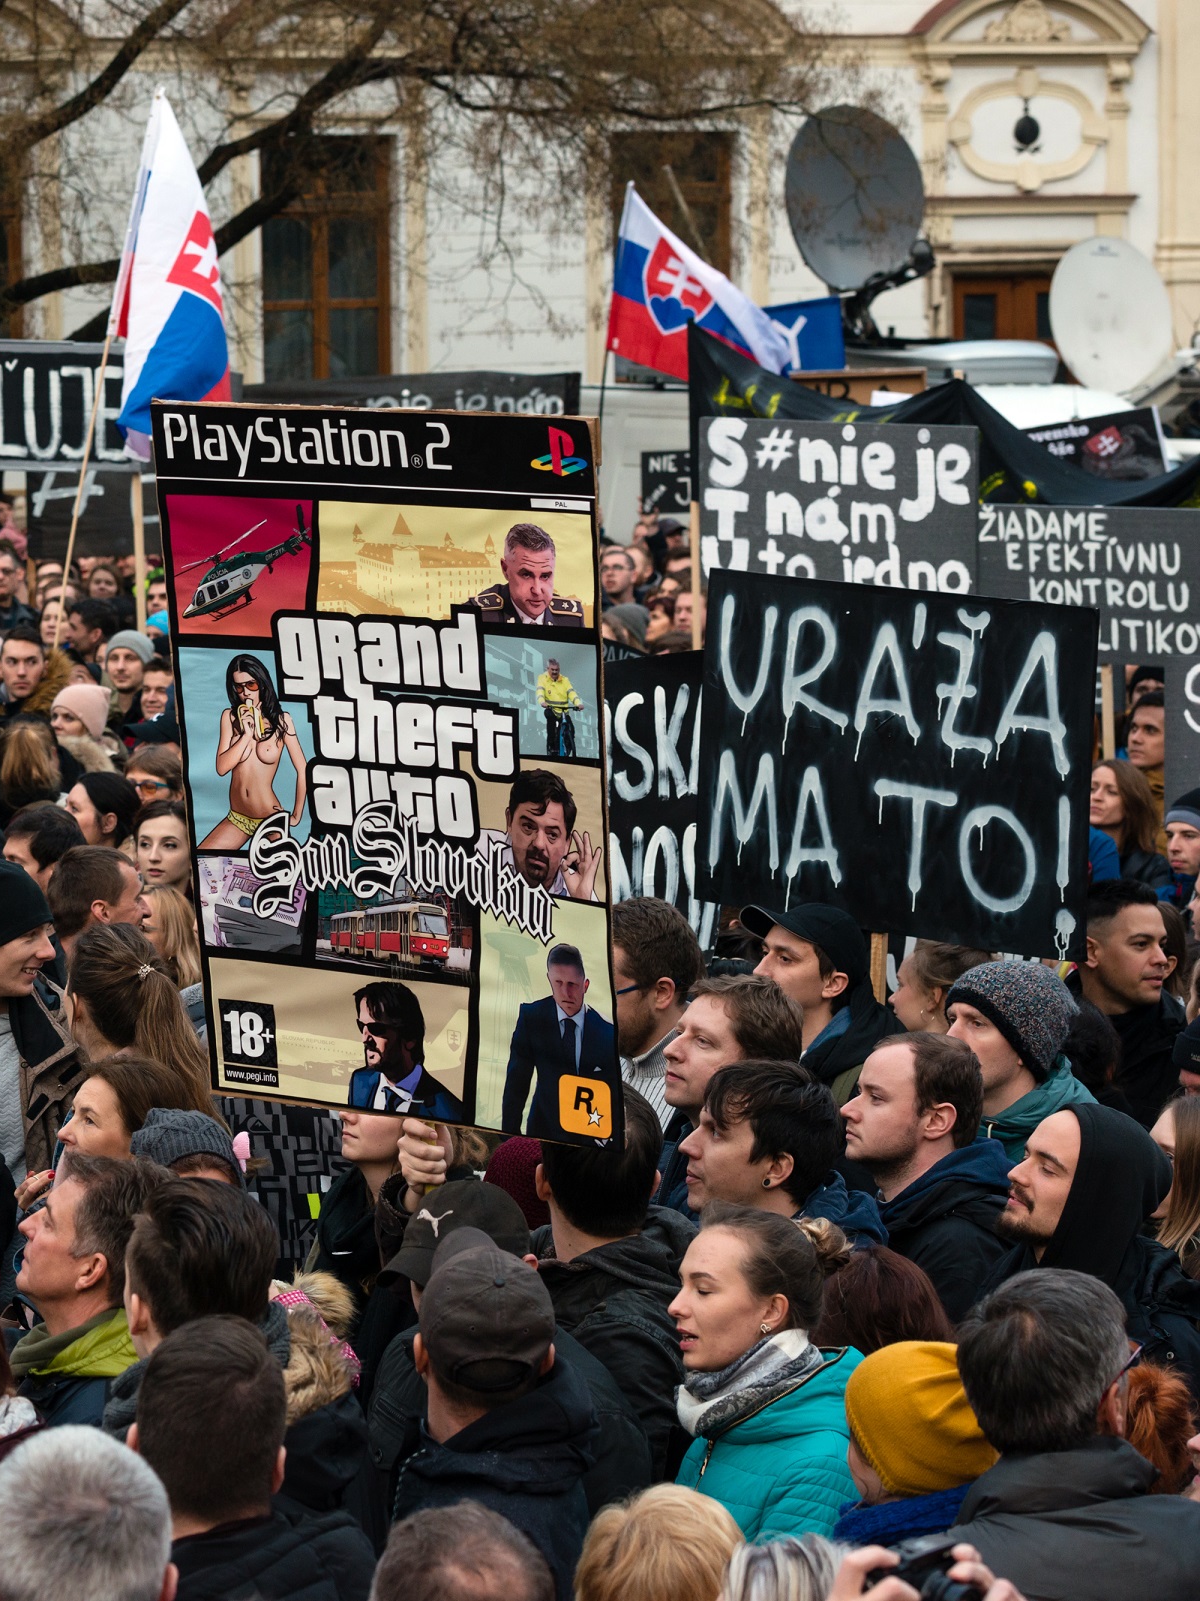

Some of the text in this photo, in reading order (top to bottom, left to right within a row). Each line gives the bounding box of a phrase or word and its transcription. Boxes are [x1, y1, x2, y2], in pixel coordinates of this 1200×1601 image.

[1027, 424, 1090, 443] vensko
[765, 485, 897, 545] nám
[978, 504, 1110, 543] ŽIADAME
[1028, 576, 1190, 612] KONTROLU
[709, 748, 843, 887] MA
[223, 1010, 275, 1058] 18+
[226, 1069, 277, 1083] www.pegi.info
